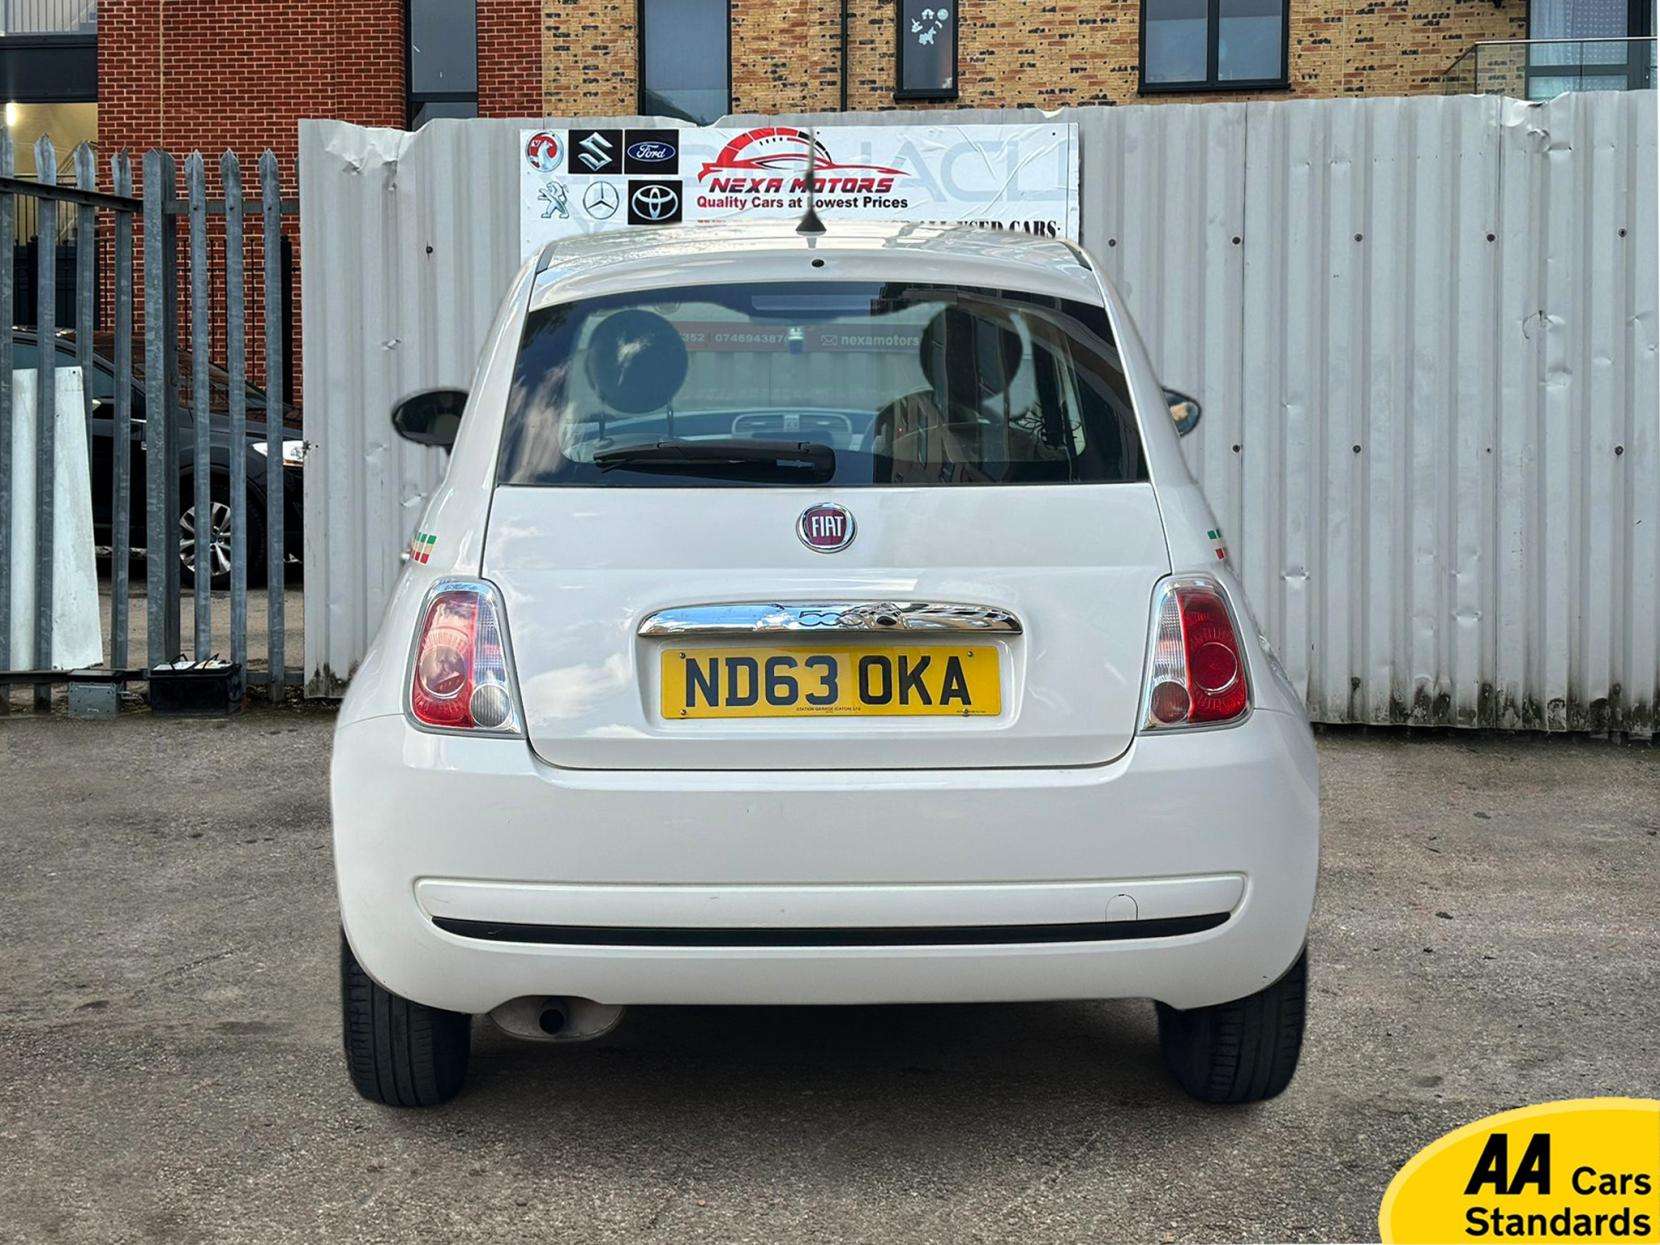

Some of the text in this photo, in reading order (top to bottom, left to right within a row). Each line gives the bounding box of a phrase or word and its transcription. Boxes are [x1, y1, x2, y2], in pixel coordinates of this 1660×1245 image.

[636, 144, 666, 158] Ford
[709, 178, 894, 193] NEXA MOTORS
[697, 196, 908, 210] Quality Cars at owest Prices
[1009, 220, 1057, 239] CARS
[811, 515, 843, 537] FIAT
[685, 655, 972, 708] ND63 OKA
